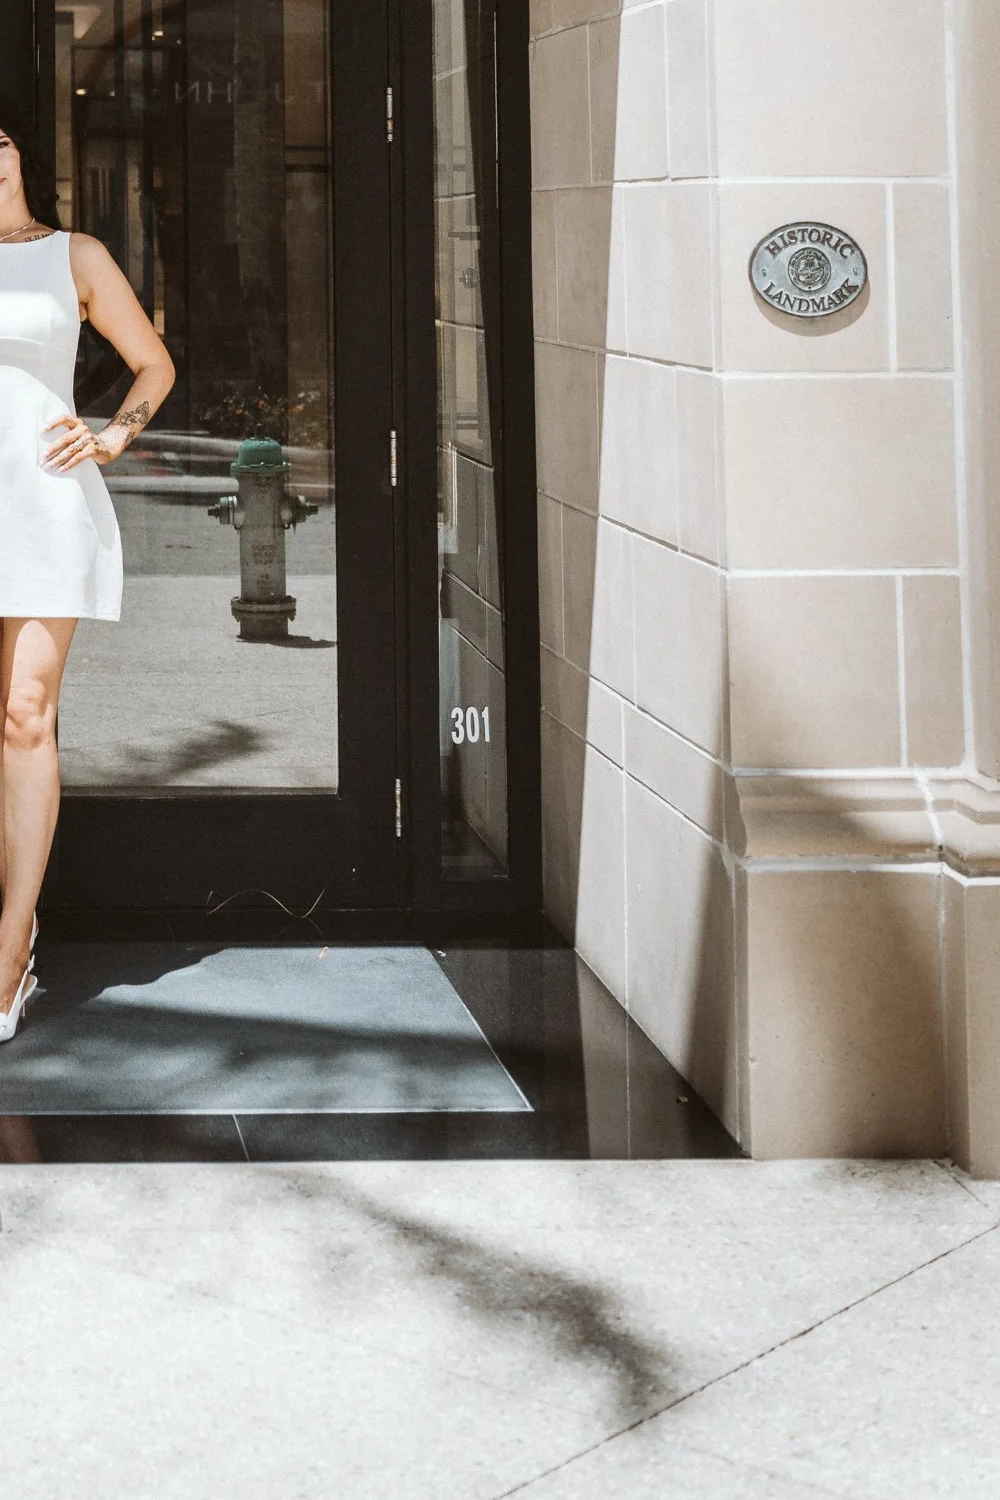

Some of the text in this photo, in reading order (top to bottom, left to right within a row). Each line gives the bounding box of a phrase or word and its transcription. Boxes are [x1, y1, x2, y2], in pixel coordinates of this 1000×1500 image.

[764, 228, 856, 260] HISTORIC
[763, 277, 859, 313] LANDMARK
[450, 706, 490, 745] 301
